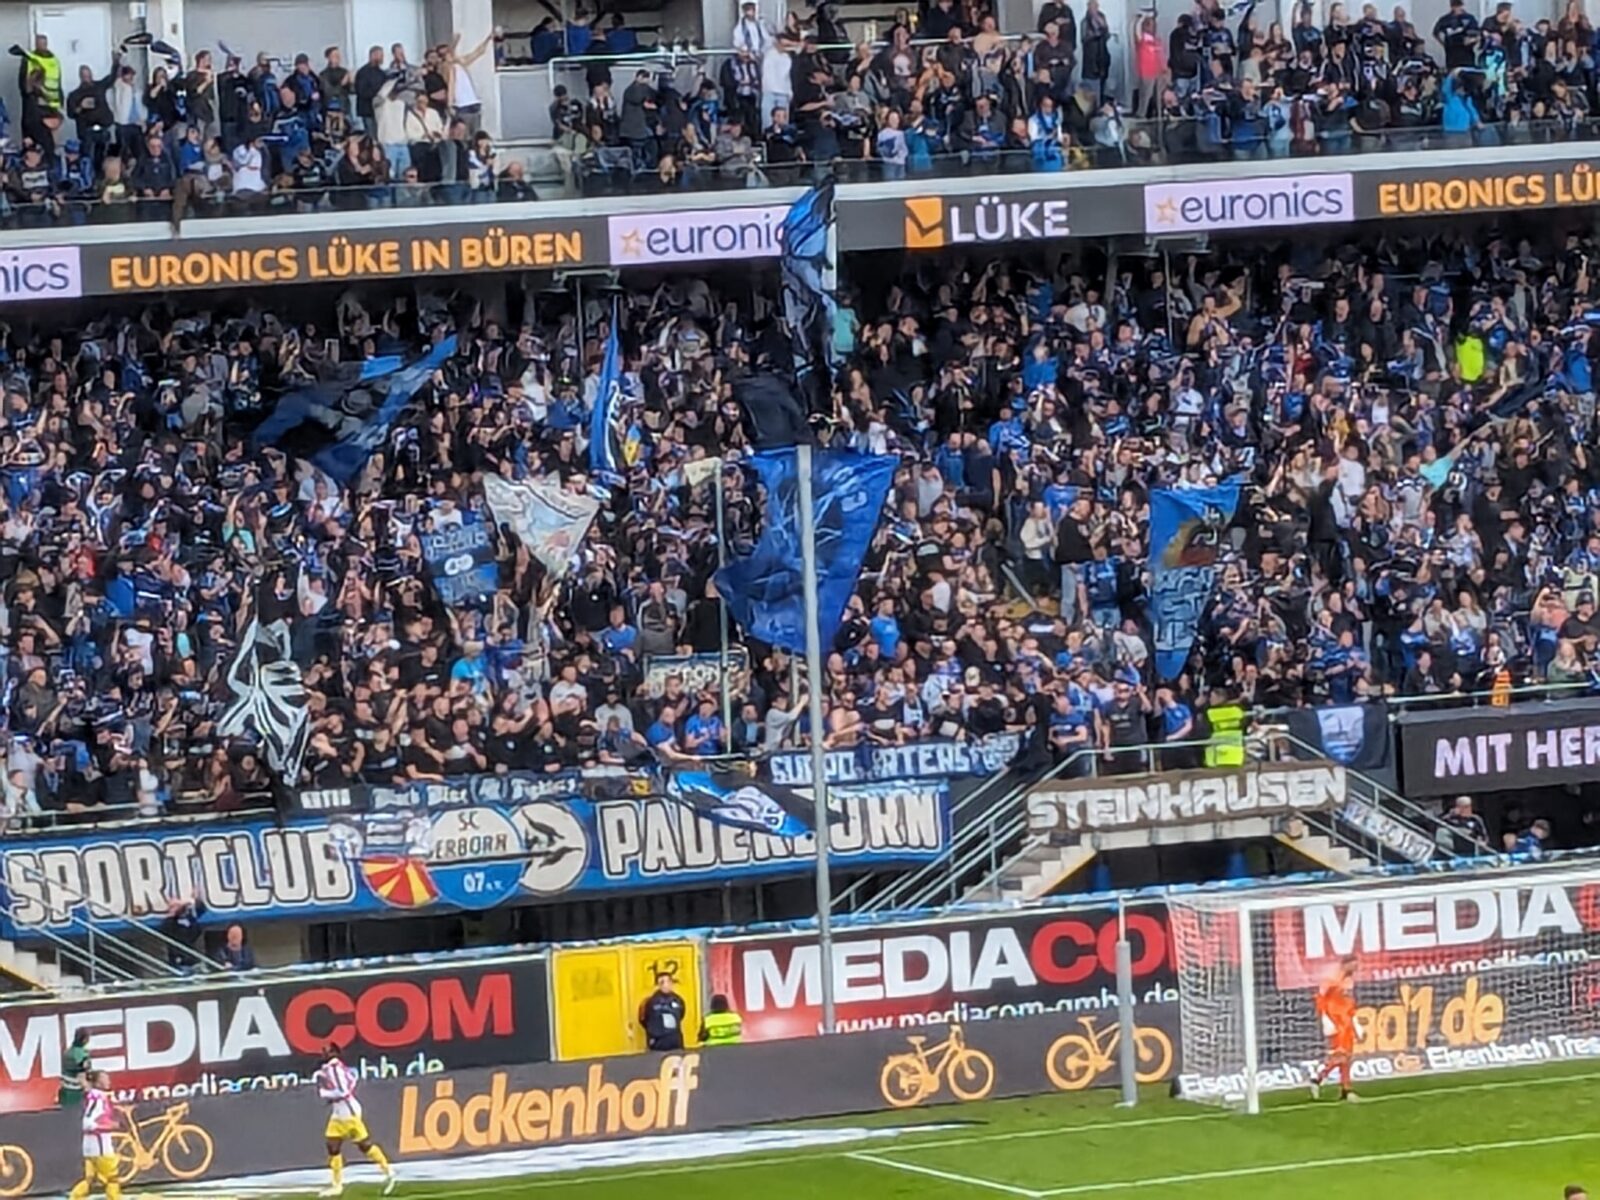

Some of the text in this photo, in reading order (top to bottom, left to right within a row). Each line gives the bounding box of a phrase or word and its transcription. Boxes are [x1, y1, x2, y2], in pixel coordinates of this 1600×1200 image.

[1180, 182, 1343, 223] euronics
[1379, 163, 1600, 214] EURONICS LÜ
[949, 196, 1070, 243] LÜKE
[110, 228, 582, 289] EURONICS LÜKE IN BÜREN
[1434, 732, 1513, 778] MIT
[458, 810, 480, 831] SC
[1026, 765, 1347, 830] STEINHAUSEN
[5, 823, 356, 931] SPORTCLUB
[463, 871, 485, 893] 07
[0, 972, 514, 1081] MEDIACOM
[1426, 1036, 1551, 1070] Eisenbach
